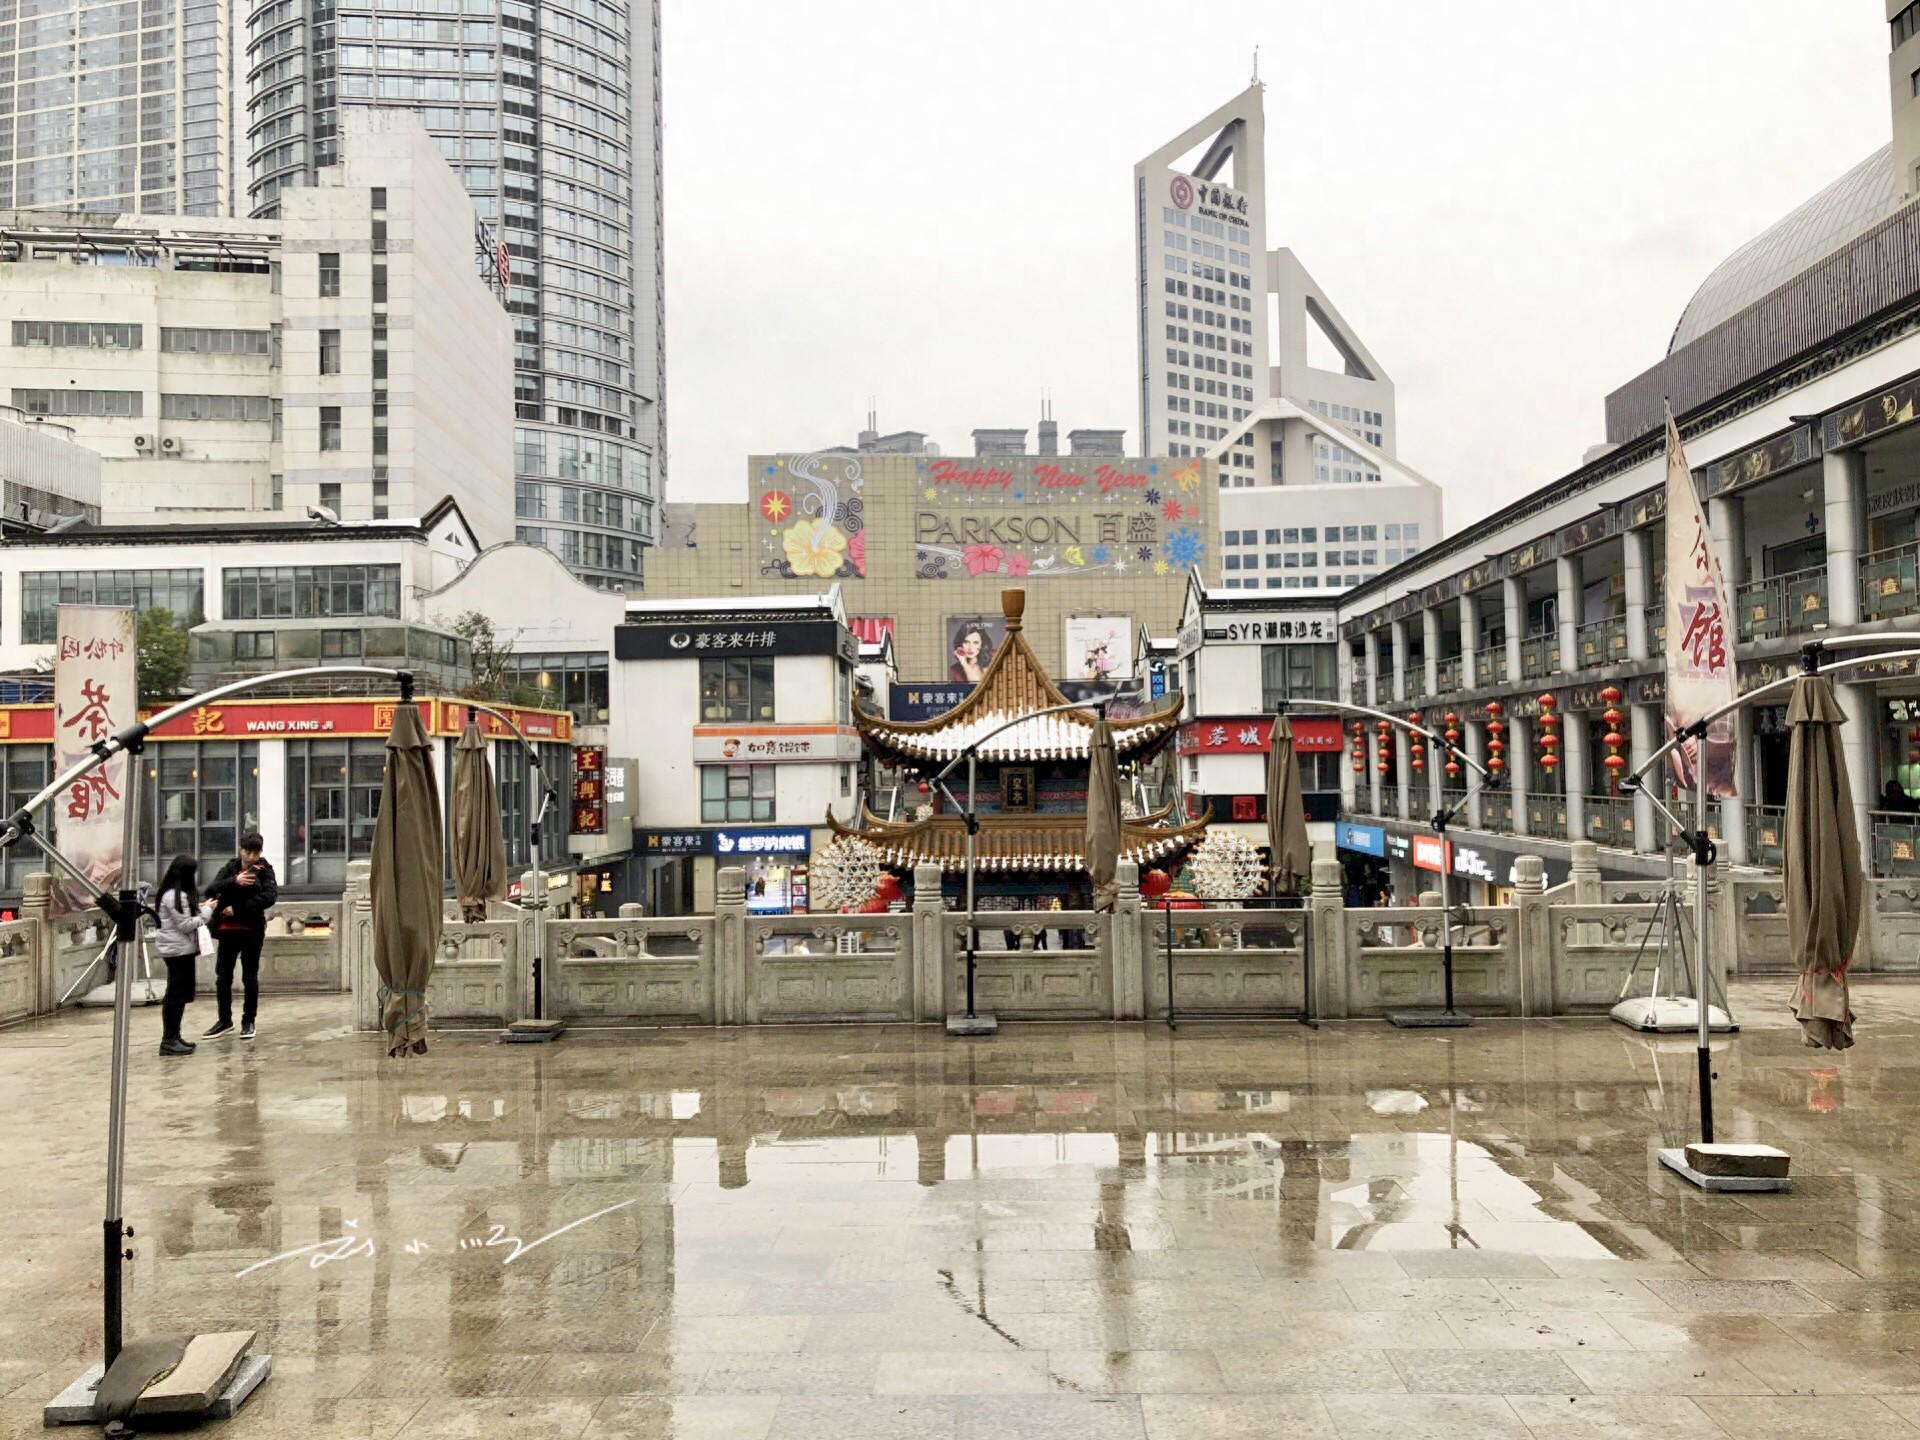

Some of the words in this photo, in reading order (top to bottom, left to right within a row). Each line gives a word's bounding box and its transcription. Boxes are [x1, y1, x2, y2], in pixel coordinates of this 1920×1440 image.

[928, 459, 1013, 492] Happy
[1034, 463, 1088, 489] New
[1093, 463, 1148, 494] Year
[914, 511, 1080, 543] PARKSON
[1093, 511, 1158, 543] 百盛
[695, 632, 777, 649] 豪客来牛排
[246, 721, 286, 731] WANG
[287, 720, 320, 731] XING
[1206, 725, 1263, 746] 蓉城
